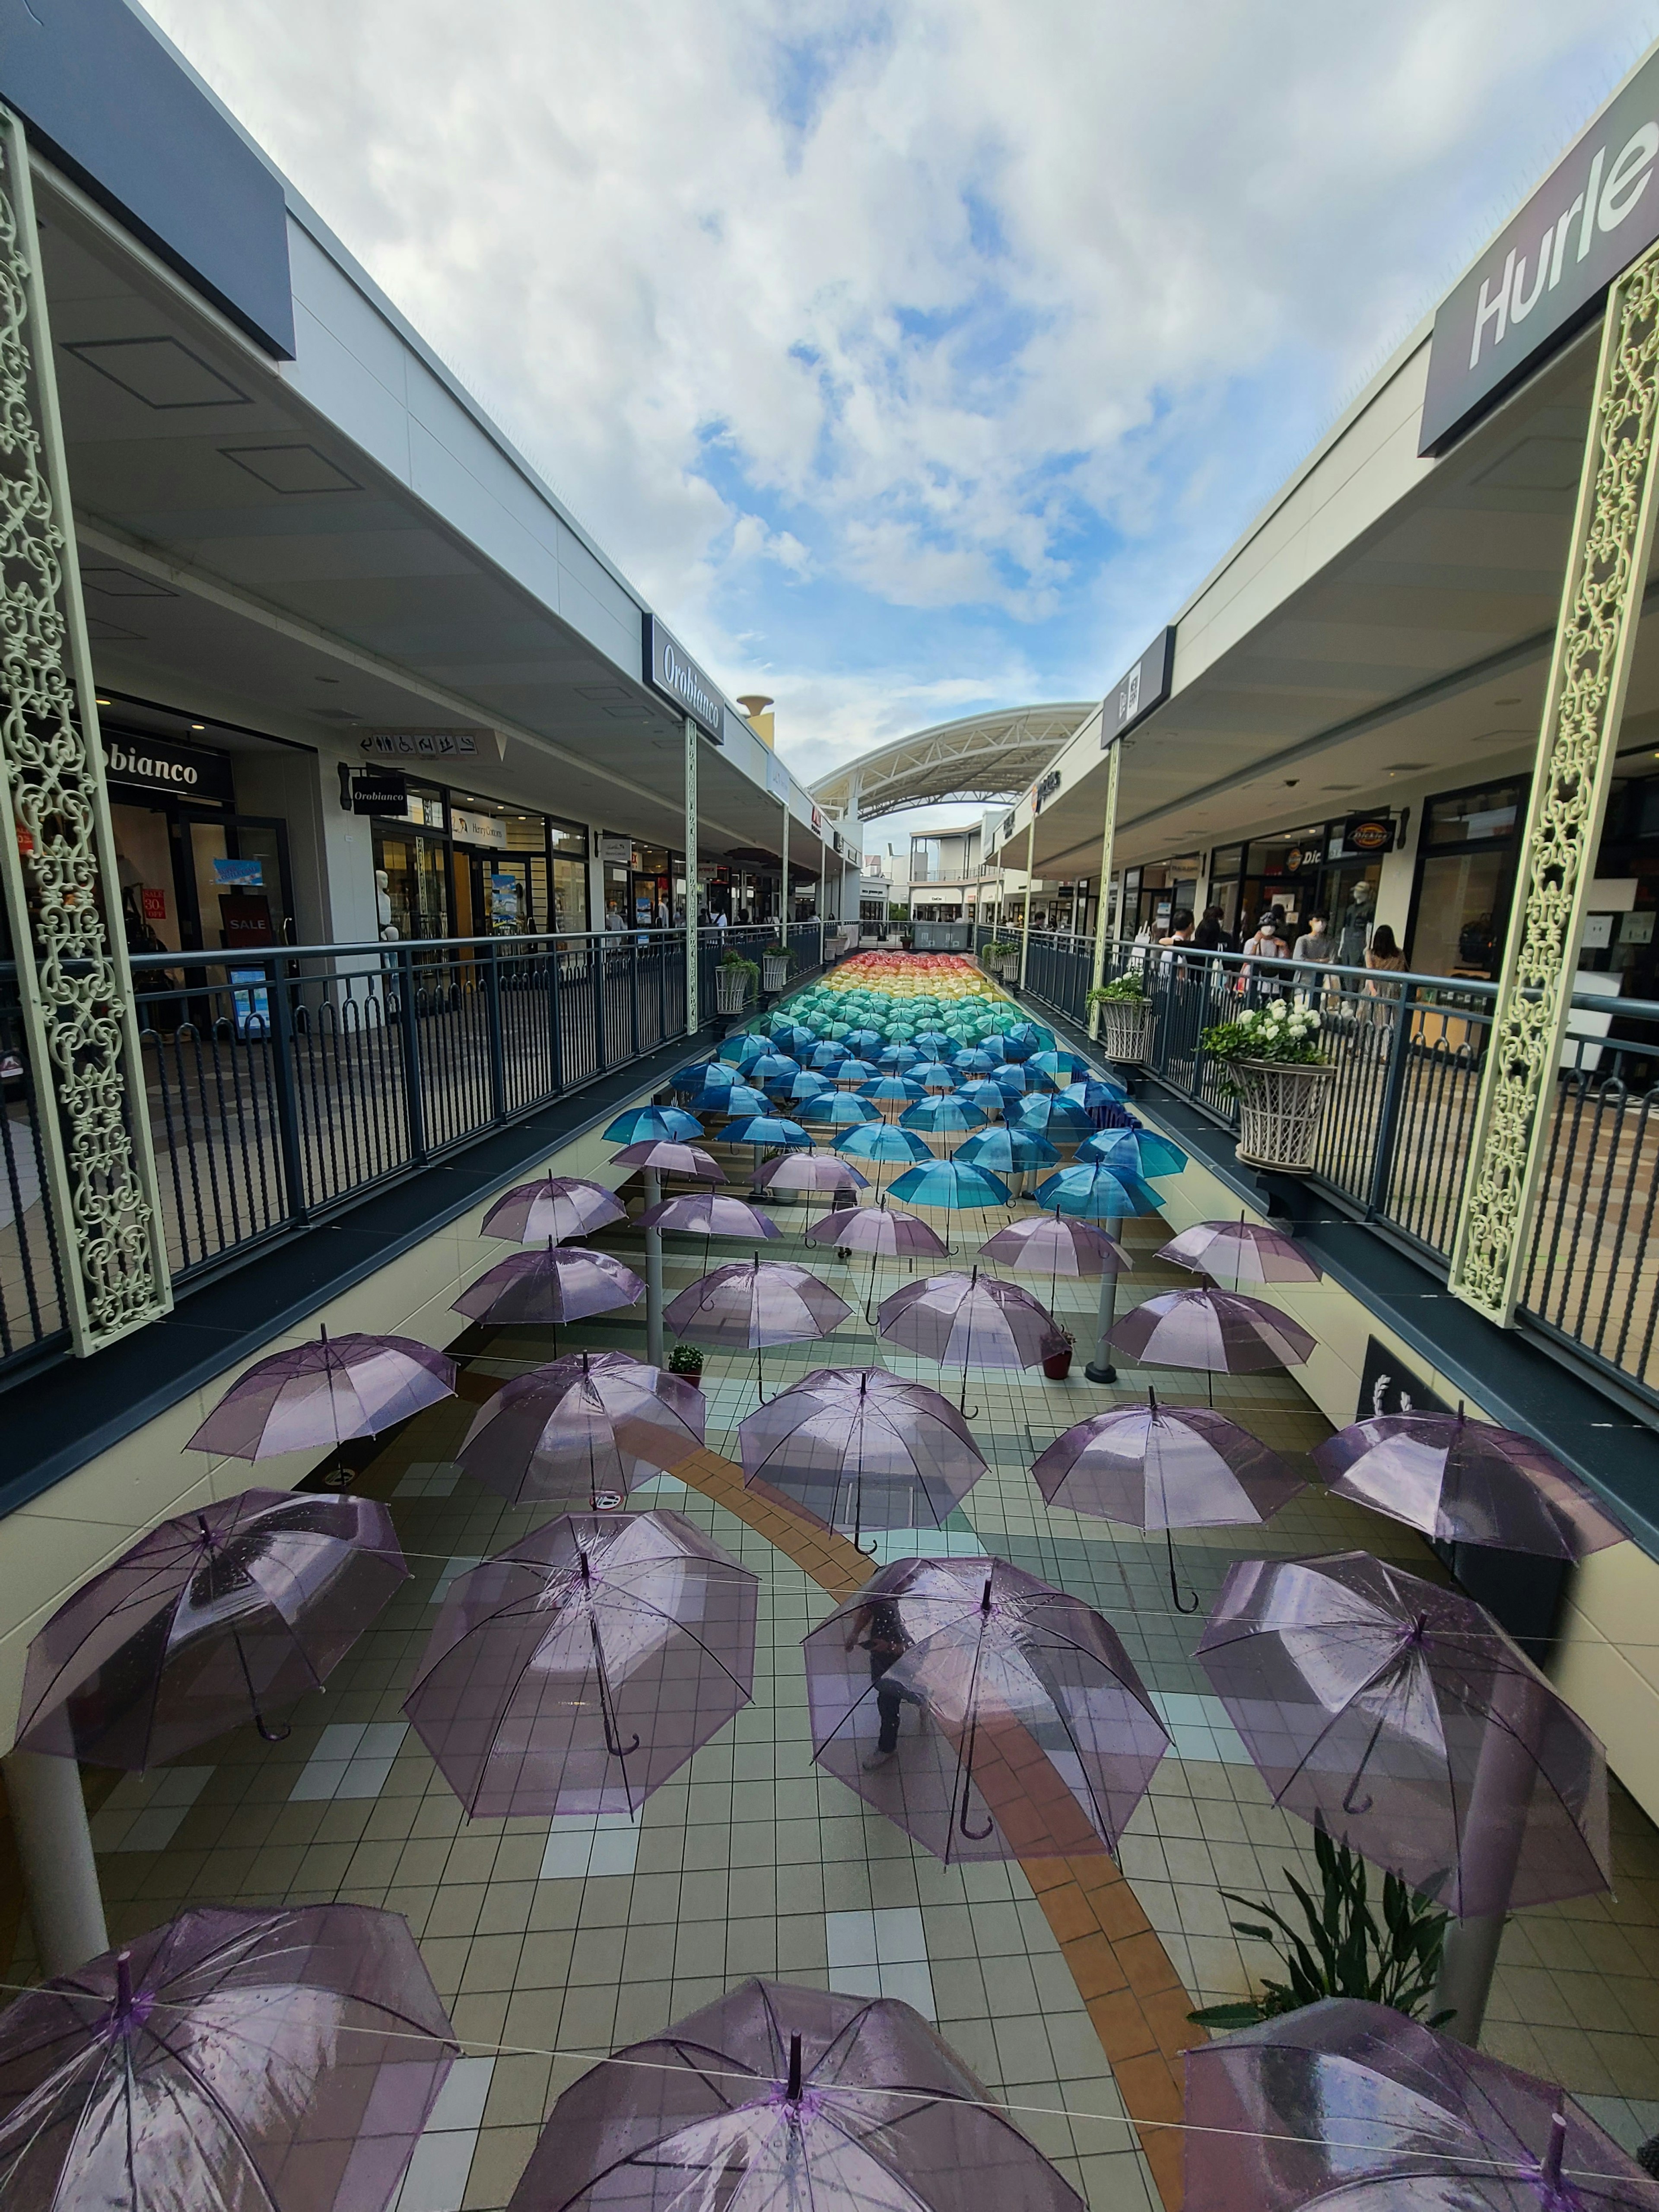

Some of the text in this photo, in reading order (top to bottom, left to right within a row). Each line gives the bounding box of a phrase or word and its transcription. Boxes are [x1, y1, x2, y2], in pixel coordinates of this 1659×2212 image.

[664, 644, 719, 728] Orobianco
[354, 791, 404, 801] Orobianco
[230, 920, 266, 929] SALE
